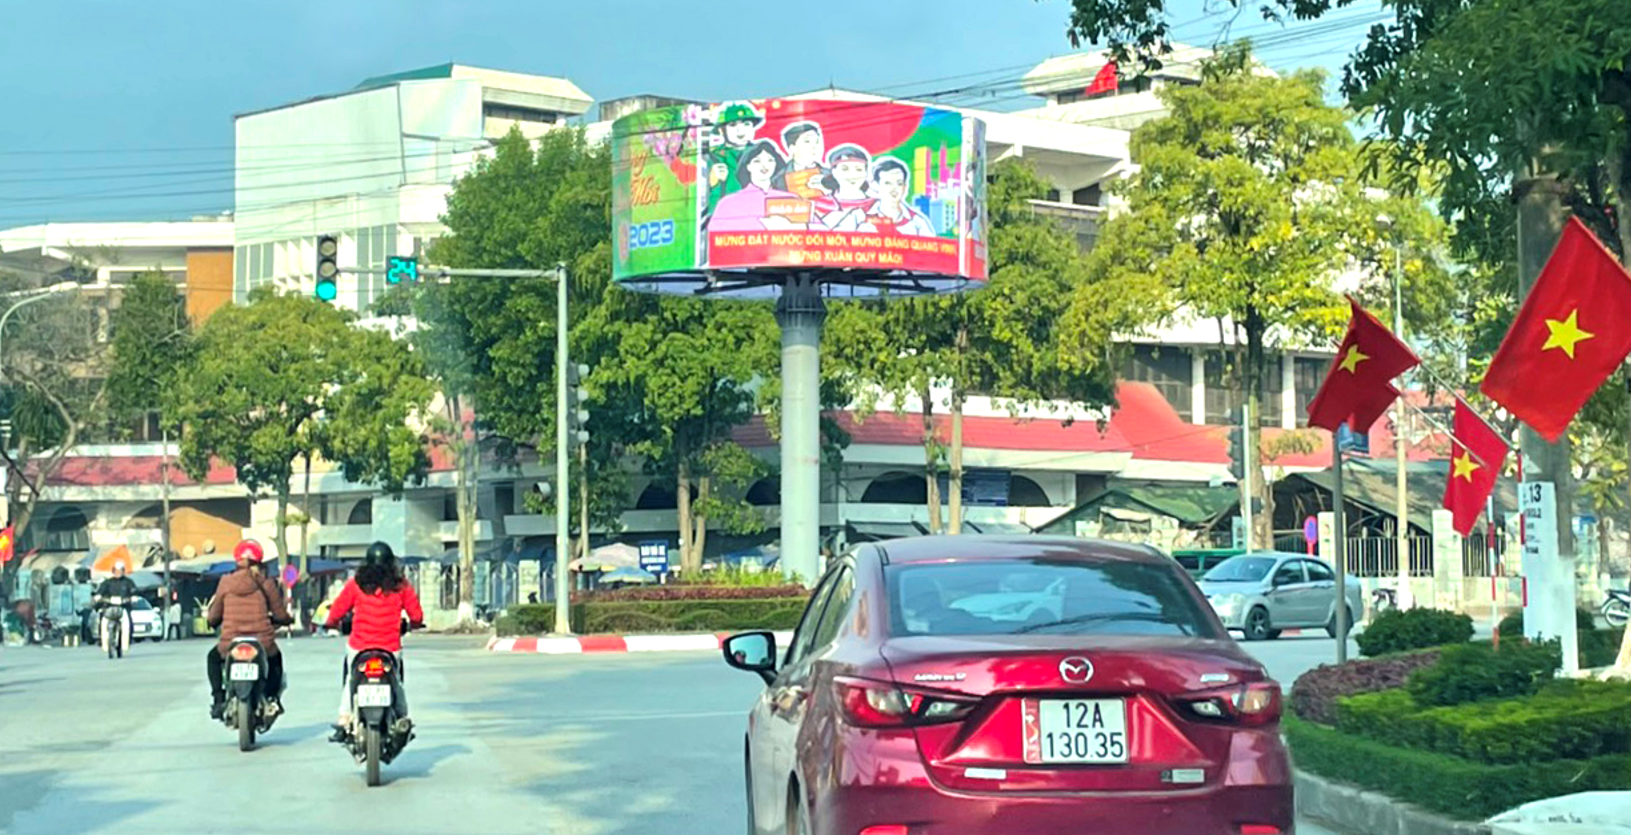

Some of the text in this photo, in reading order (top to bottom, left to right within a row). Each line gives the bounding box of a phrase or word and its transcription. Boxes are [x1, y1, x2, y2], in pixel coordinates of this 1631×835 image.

[630, 220, 673, 250] 2023
[715, 234, 746, 246] MỪNG
[771, 232, 804, 245] NƯỚC
[824, 249, 853, 262] XUÂN
[388, 258, 416, 281] 24
[1063, 702, 1105, 729] 12A
[1046, 732, 1124, 758] 130.35
